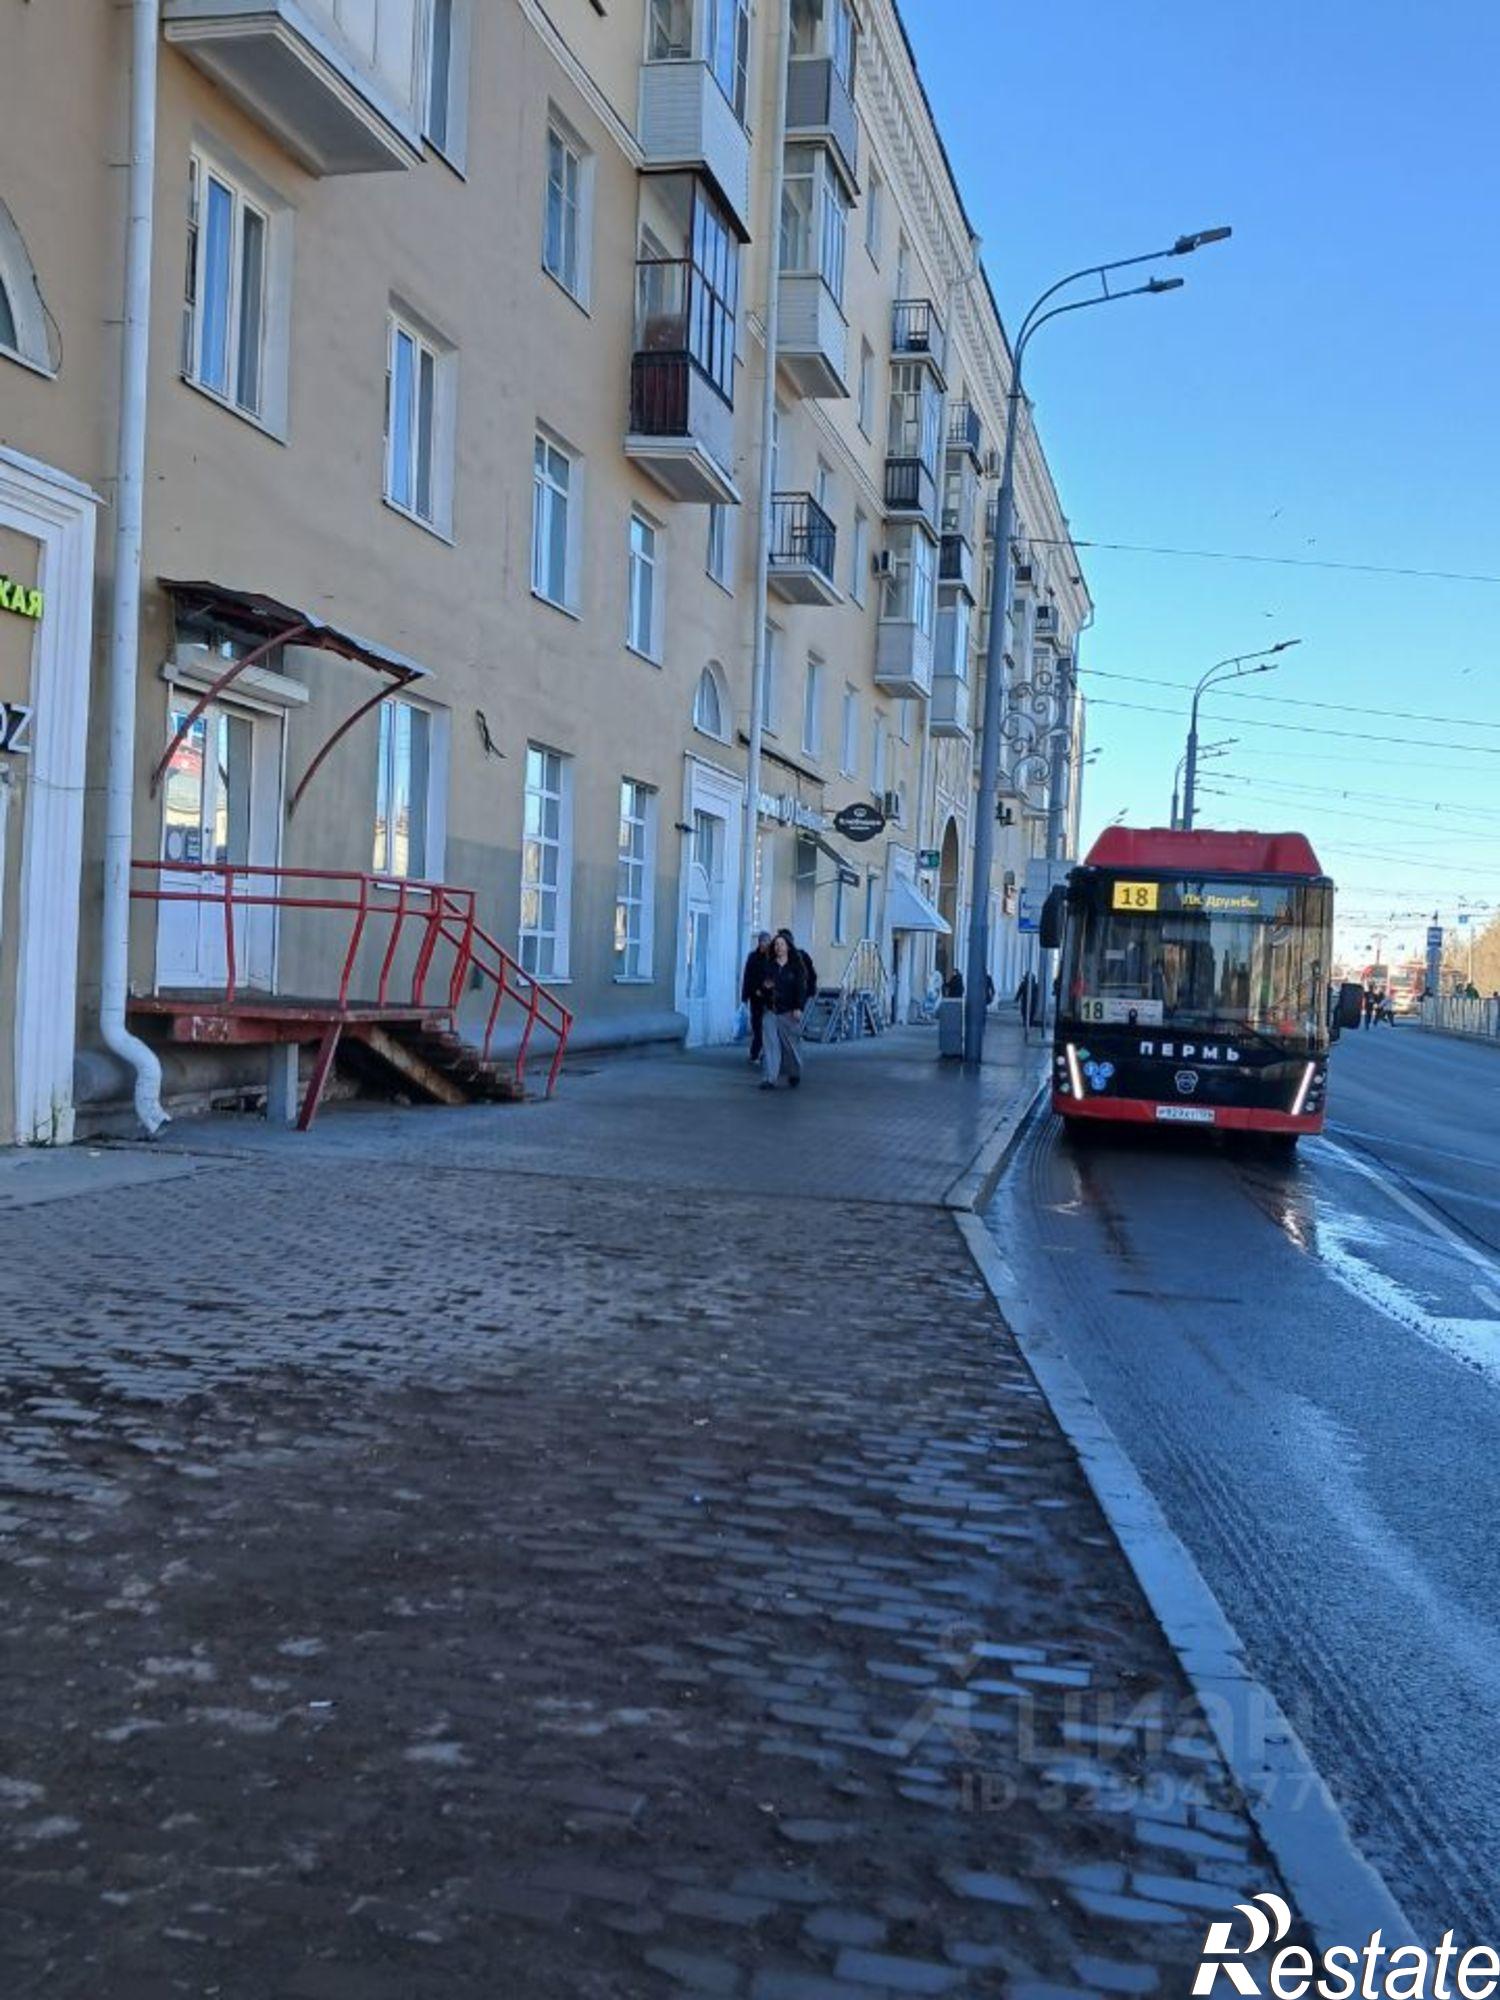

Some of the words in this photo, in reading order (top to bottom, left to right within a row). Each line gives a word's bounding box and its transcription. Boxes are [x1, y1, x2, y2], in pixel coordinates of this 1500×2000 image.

[1120, 886, 1150, 907] 18
[1083, 1000, 1103, 1019] 18
[1139, 1040, 1240, 1061] ПЕРМЬ
